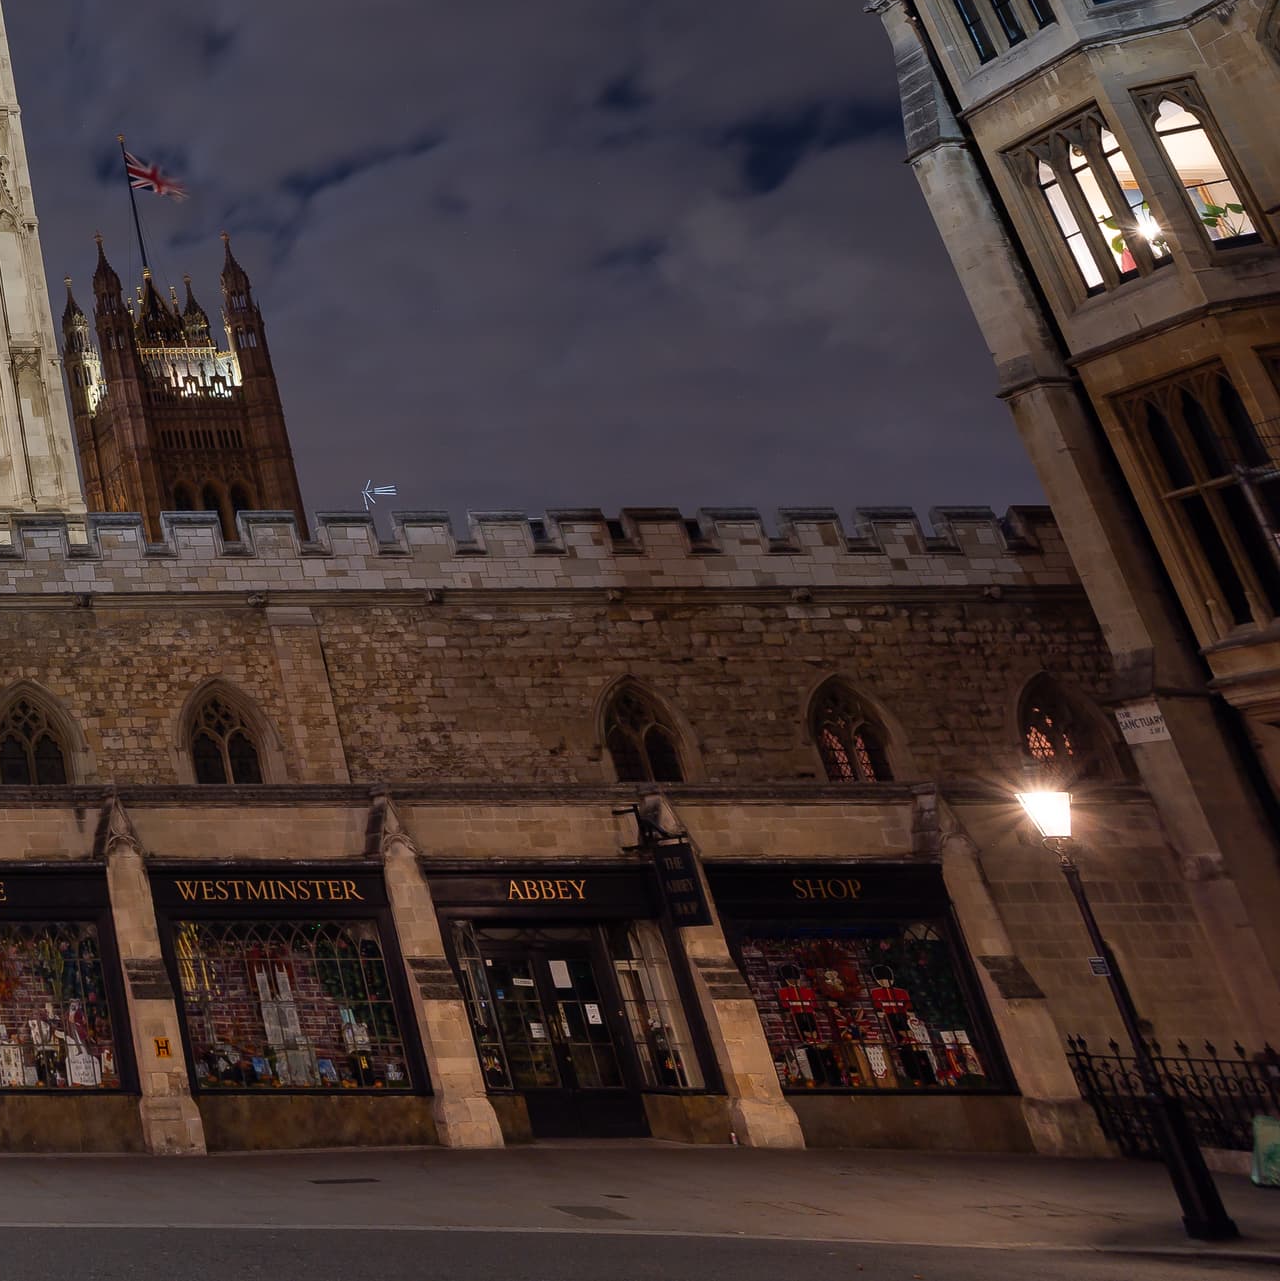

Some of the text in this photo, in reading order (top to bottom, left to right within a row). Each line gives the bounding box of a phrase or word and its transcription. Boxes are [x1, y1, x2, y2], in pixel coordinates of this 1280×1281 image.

[175, 880, 365, 901] WESTMINSTER
[507, 879, 586, 900] ABBEY
[792, 879, 862, 899] SHOP
[154, 1039, 171, 1056] H
